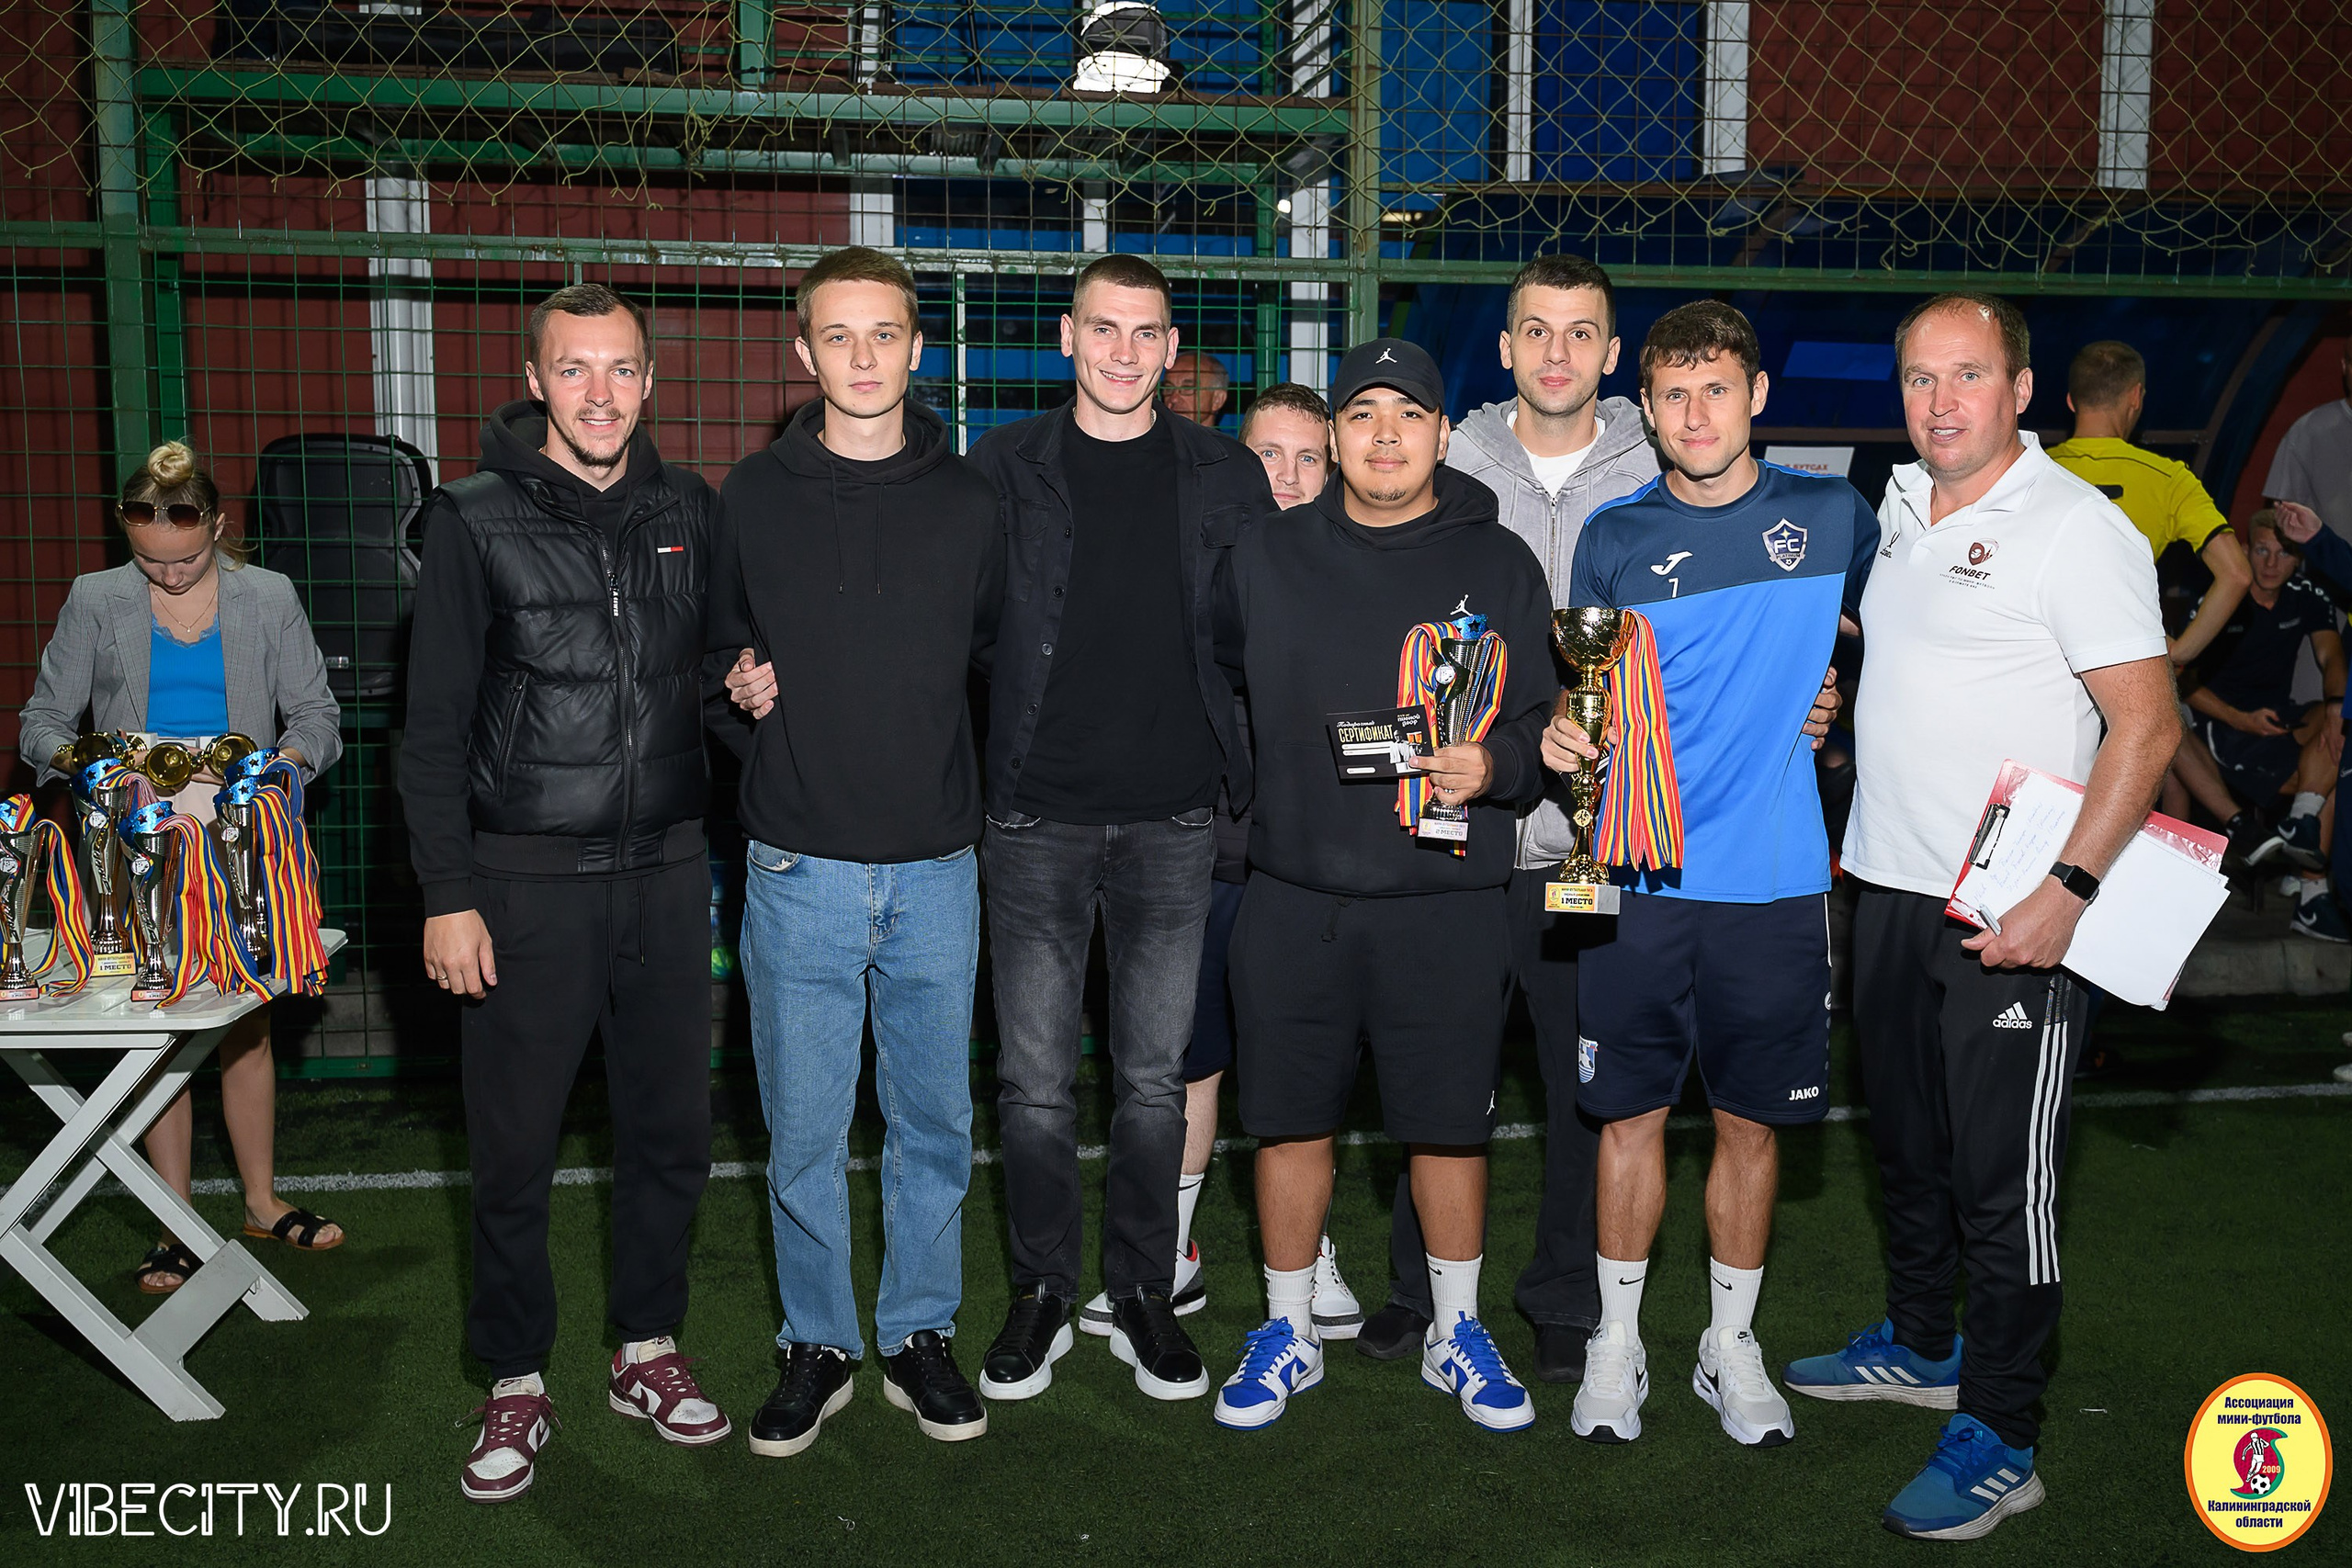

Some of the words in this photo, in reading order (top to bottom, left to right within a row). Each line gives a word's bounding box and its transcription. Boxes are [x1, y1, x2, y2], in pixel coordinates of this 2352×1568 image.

[1773, 538, 1800, 553] FC
[1949, 566, 1991, 581] FONBET
[1668, 577, 1679, 598] 7
[1338, 724, 1394, 743] СЕРТИФИКАТ
[1992, 1019, 2033, 1029] adidas
[1789, 1086, 1819, 1100] JAKO
